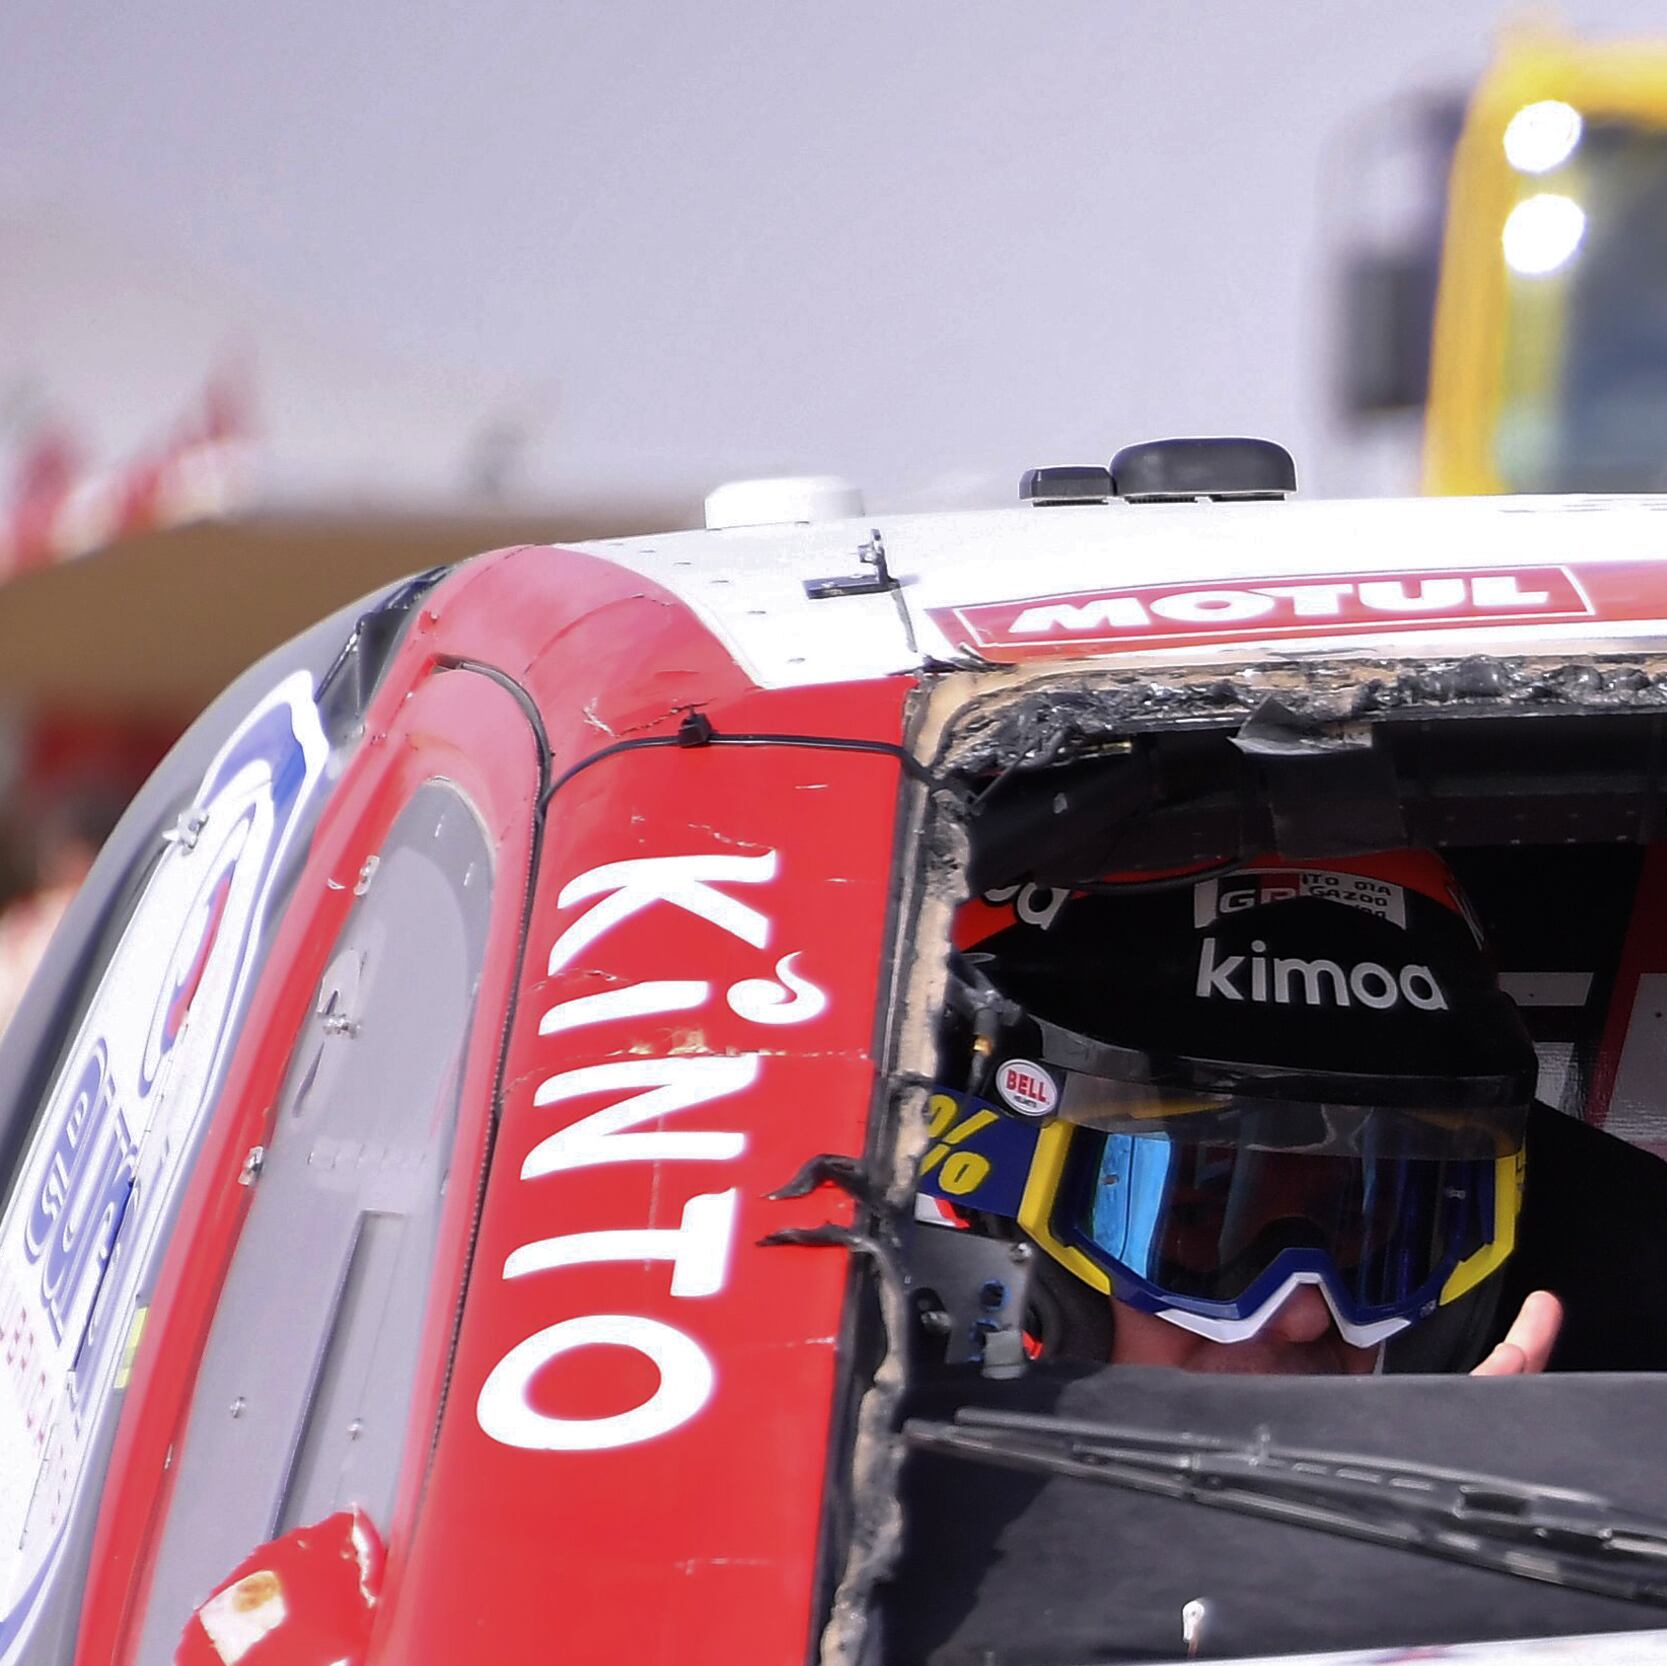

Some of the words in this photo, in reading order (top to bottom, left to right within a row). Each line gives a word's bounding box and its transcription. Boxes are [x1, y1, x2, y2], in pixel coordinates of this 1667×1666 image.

[1008, 575, 1549, 635] MOTUL
[1196, 936, 1449, 1010] kimoa
[1004, 1068, 1048, 1103] BELL
